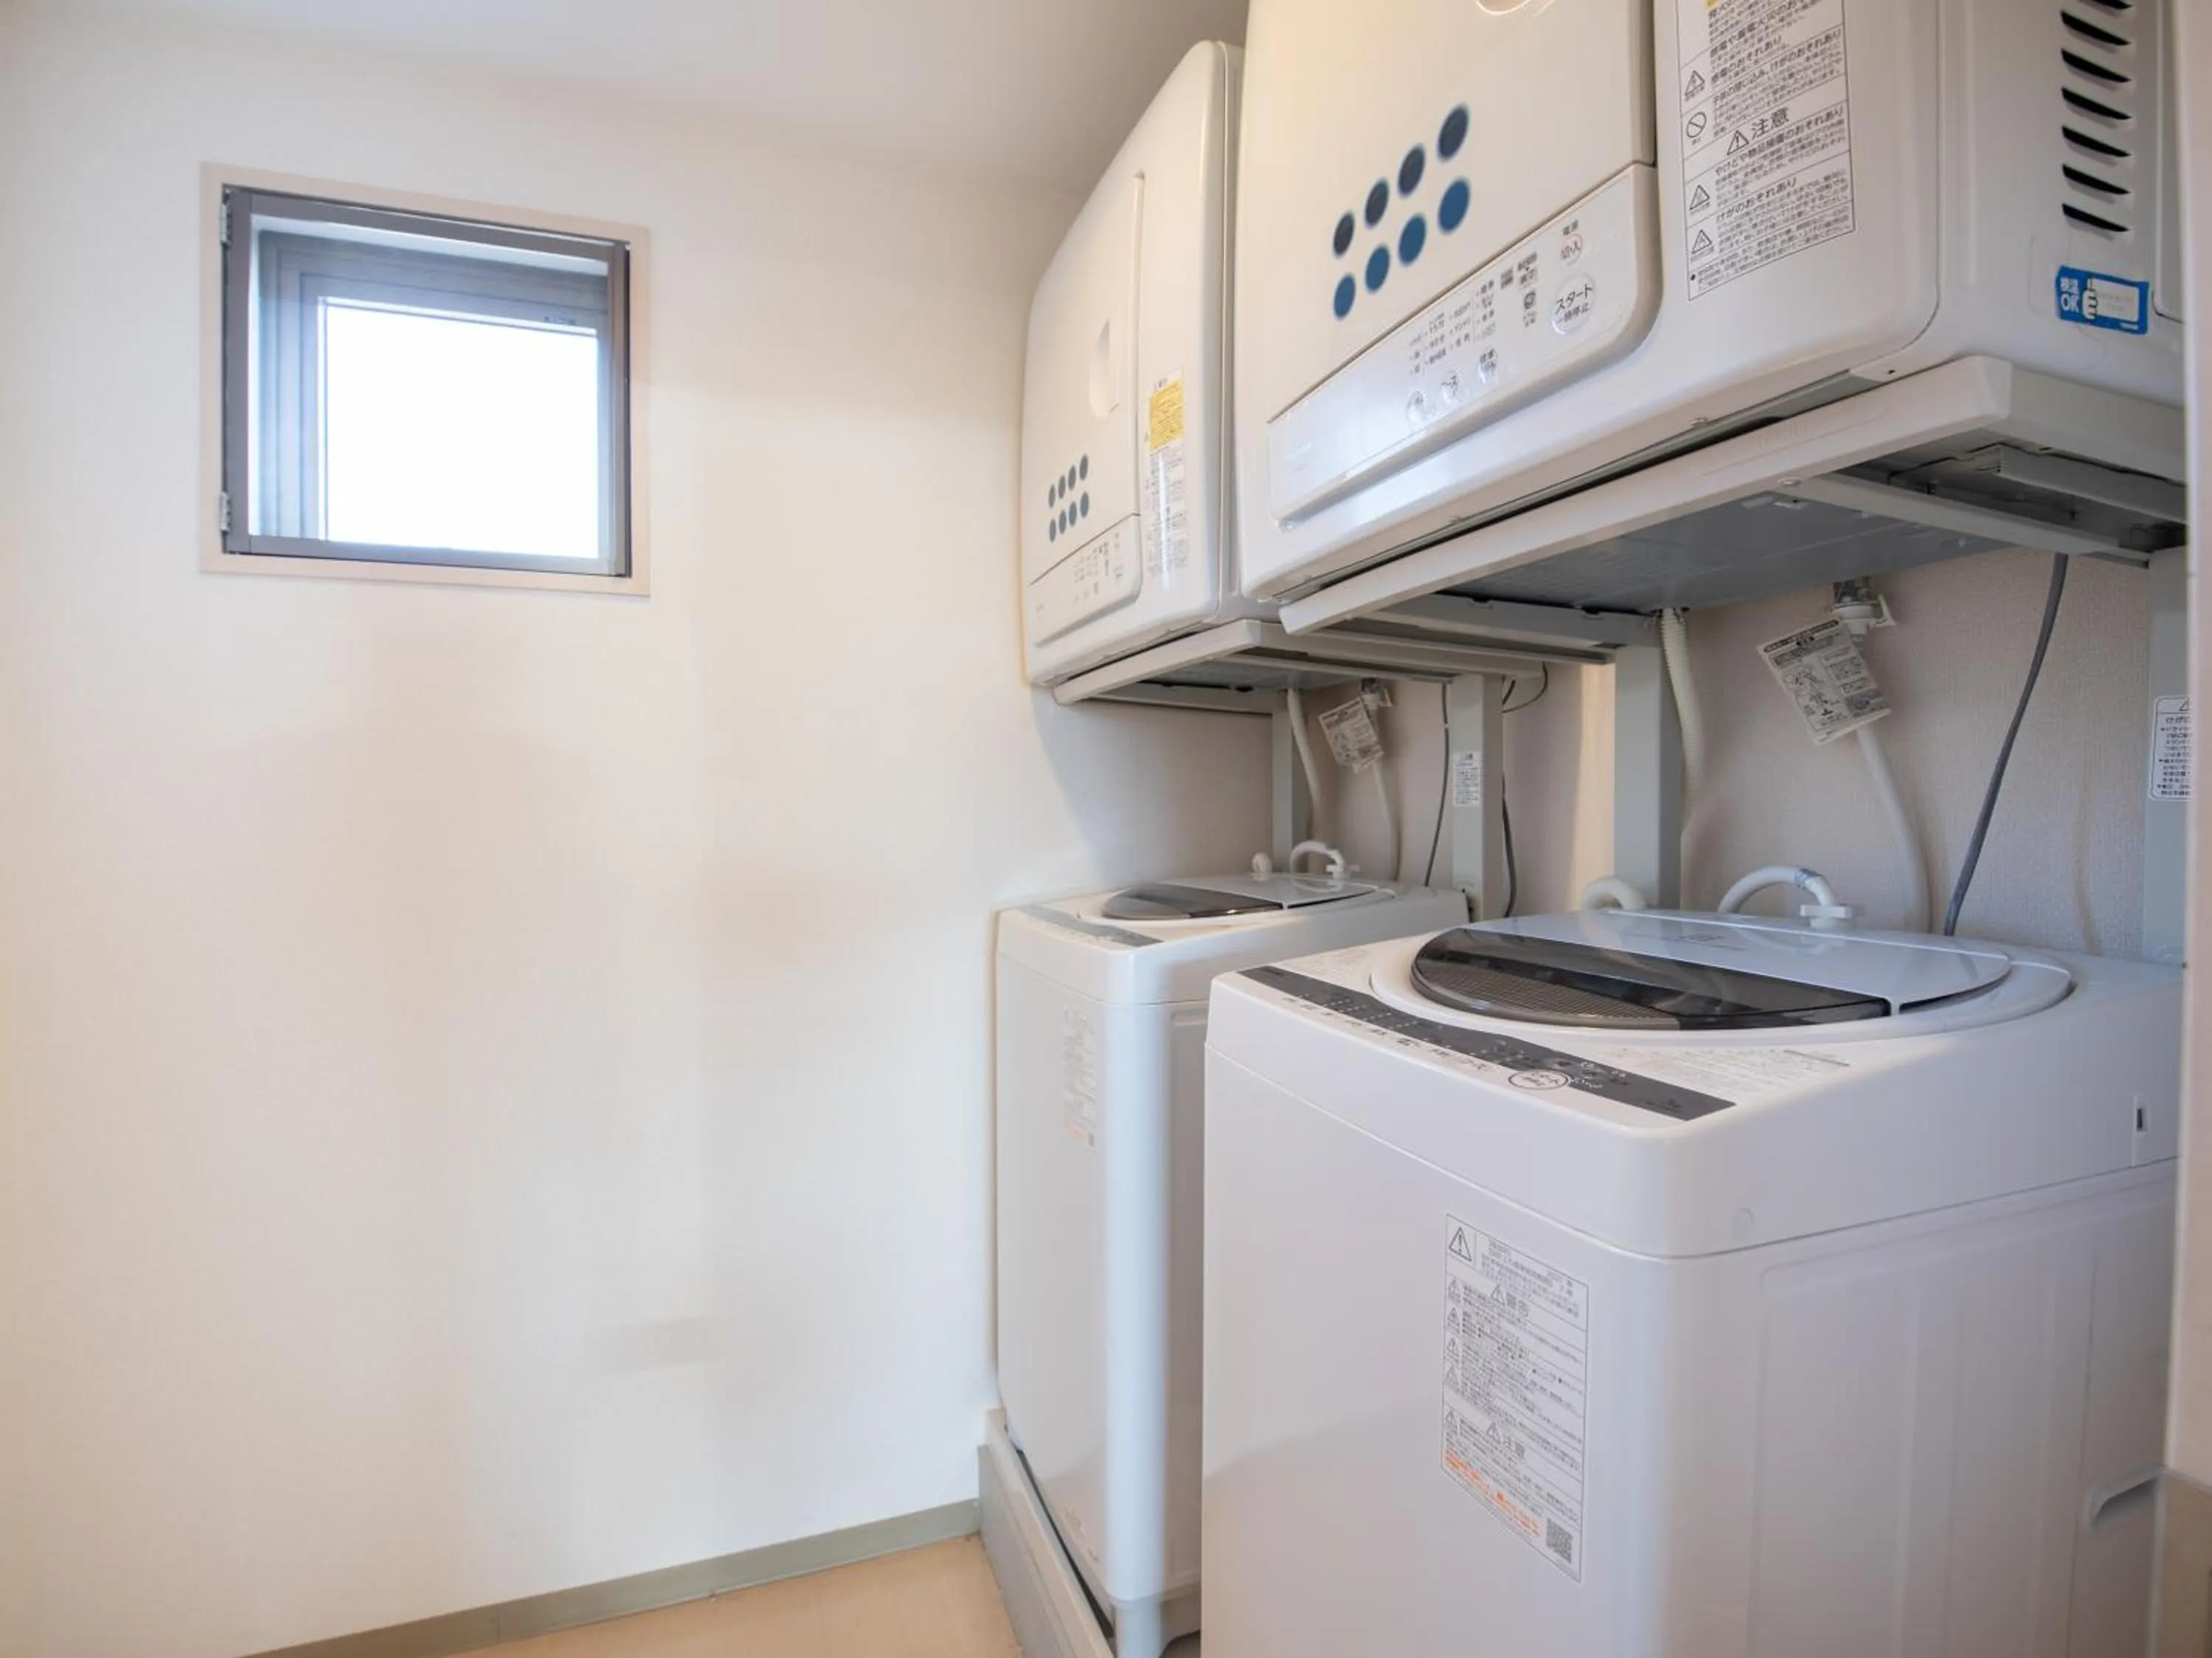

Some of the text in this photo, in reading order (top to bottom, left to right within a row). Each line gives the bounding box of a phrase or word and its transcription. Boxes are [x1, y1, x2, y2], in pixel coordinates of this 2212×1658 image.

[1751, 107, 1790, 140] 注意
[1555, 282, 1593, 316] スタート
[2061, 293, 2079, 313] OK
